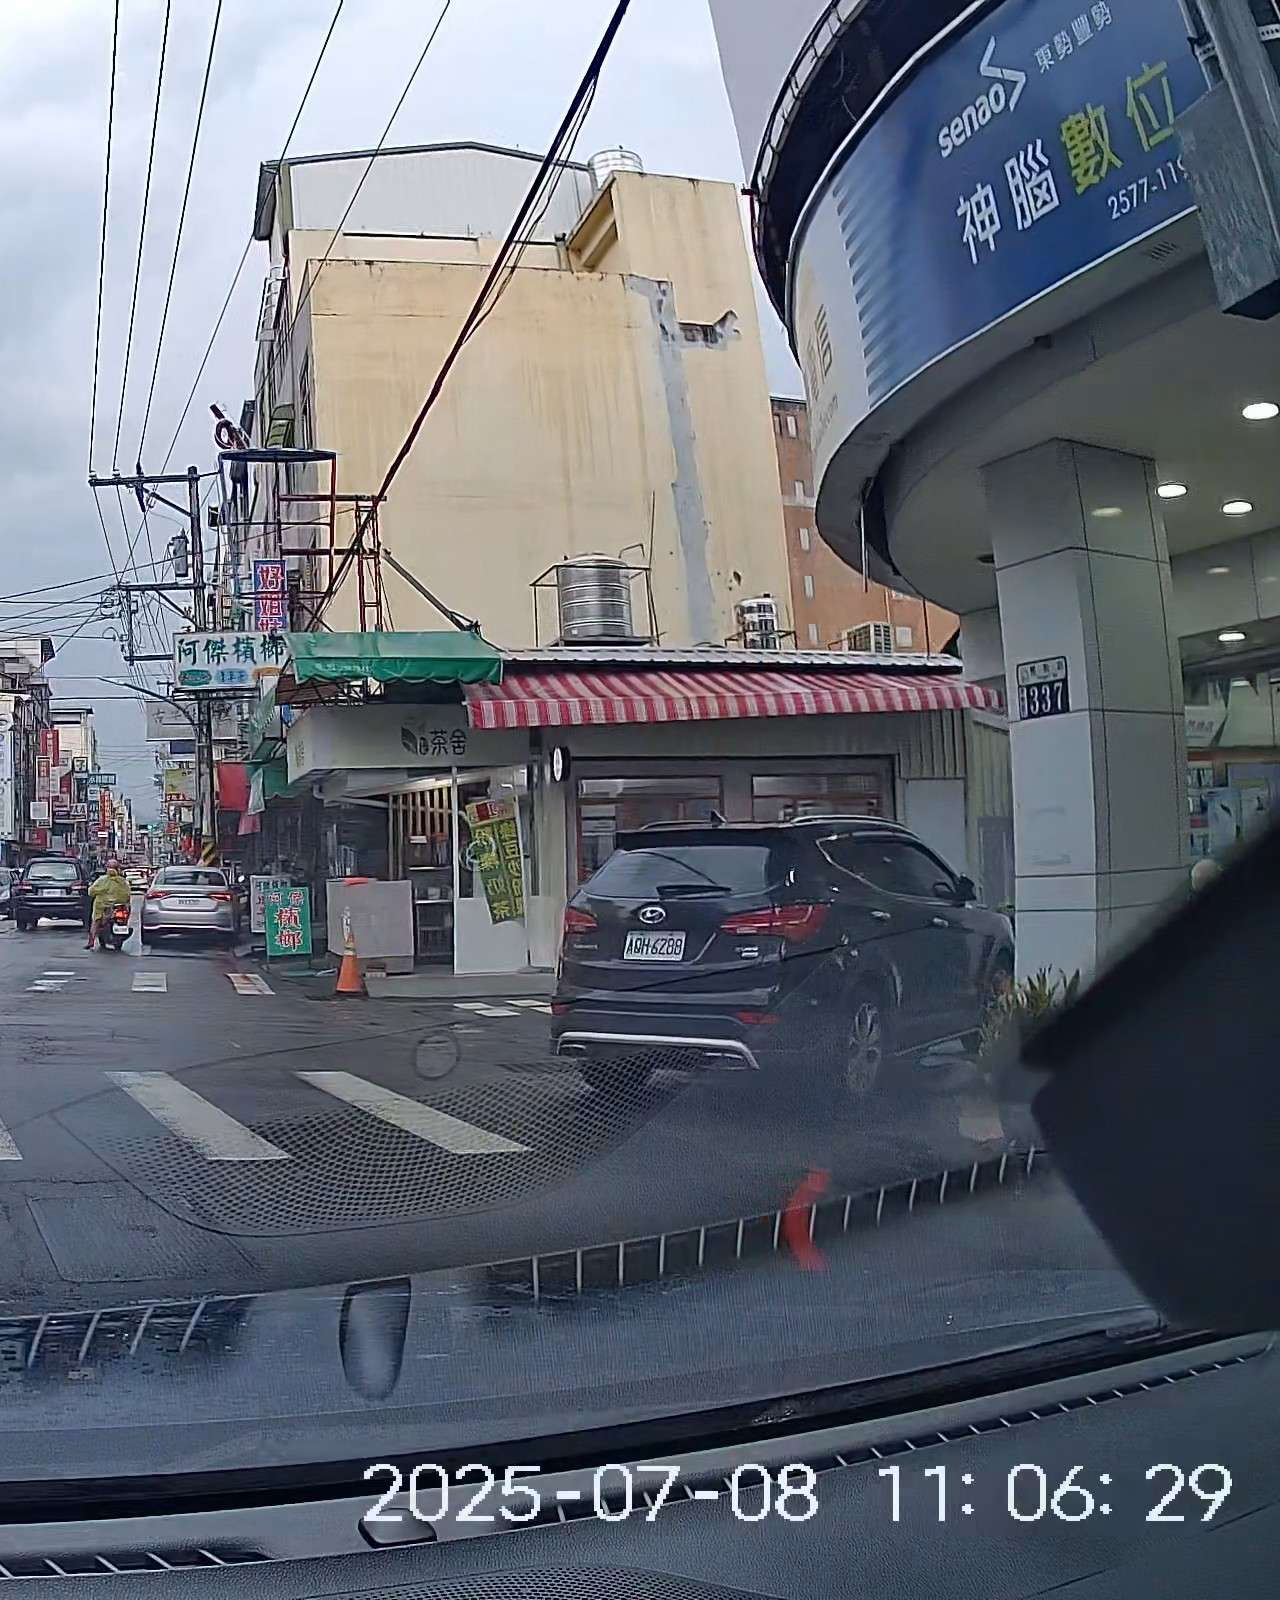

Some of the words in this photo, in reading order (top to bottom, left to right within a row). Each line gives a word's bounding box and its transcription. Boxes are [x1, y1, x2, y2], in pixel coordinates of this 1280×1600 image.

[1034, 1, 1112, 73] 東勢豐勢
[938, 82, 1007, 158] senao
[957, 61, 1176, 264] 神腦數位
[1029, 682, 1062, 715] 337
